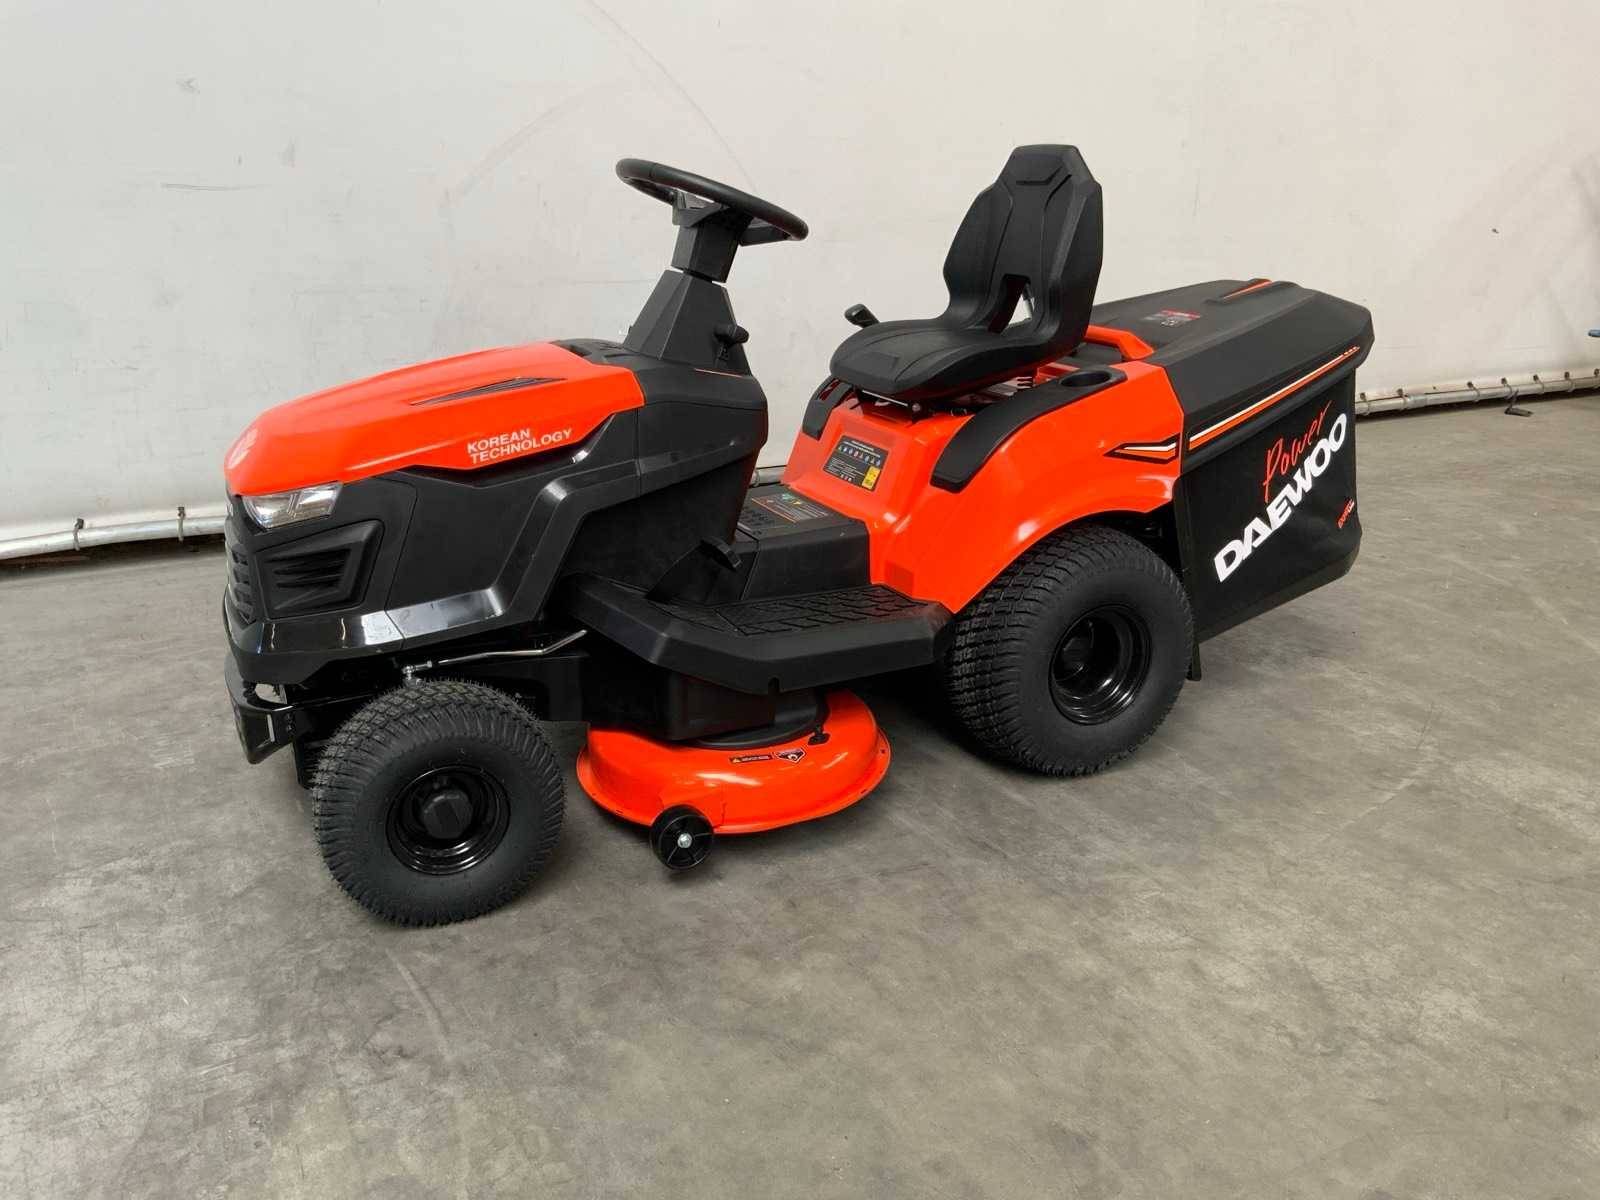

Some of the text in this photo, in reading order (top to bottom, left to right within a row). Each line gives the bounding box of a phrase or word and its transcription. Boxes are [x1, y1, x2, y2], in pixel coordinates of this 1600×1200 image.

[467, 428, 531, 454] KOREAN
[470, 428, 572, 464] TECHNOLOGY
[1261, 399, 1333, 504] Power
[1213, 412, 1347, 583] DAEWOO
